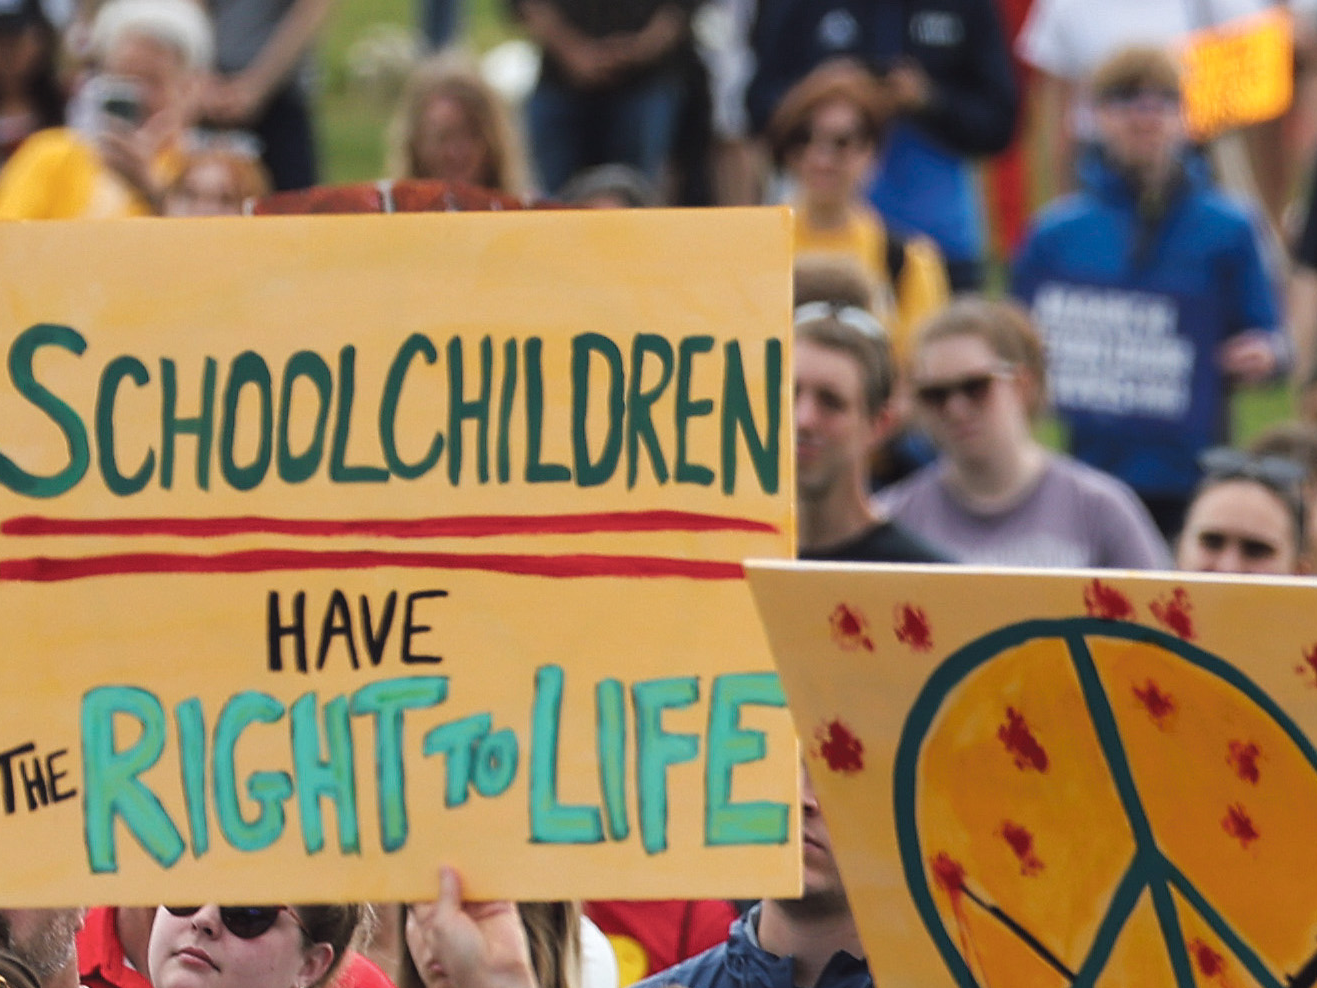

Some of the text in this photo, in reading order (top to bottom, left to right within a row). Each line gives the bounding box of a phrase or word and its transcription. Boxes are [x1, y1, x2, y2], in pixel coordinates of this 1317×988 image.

[265, 589, 449, 673] HAVE
[80, 675, 449, 875] RIGHT
[528, 663, 789, 856] LIFE
